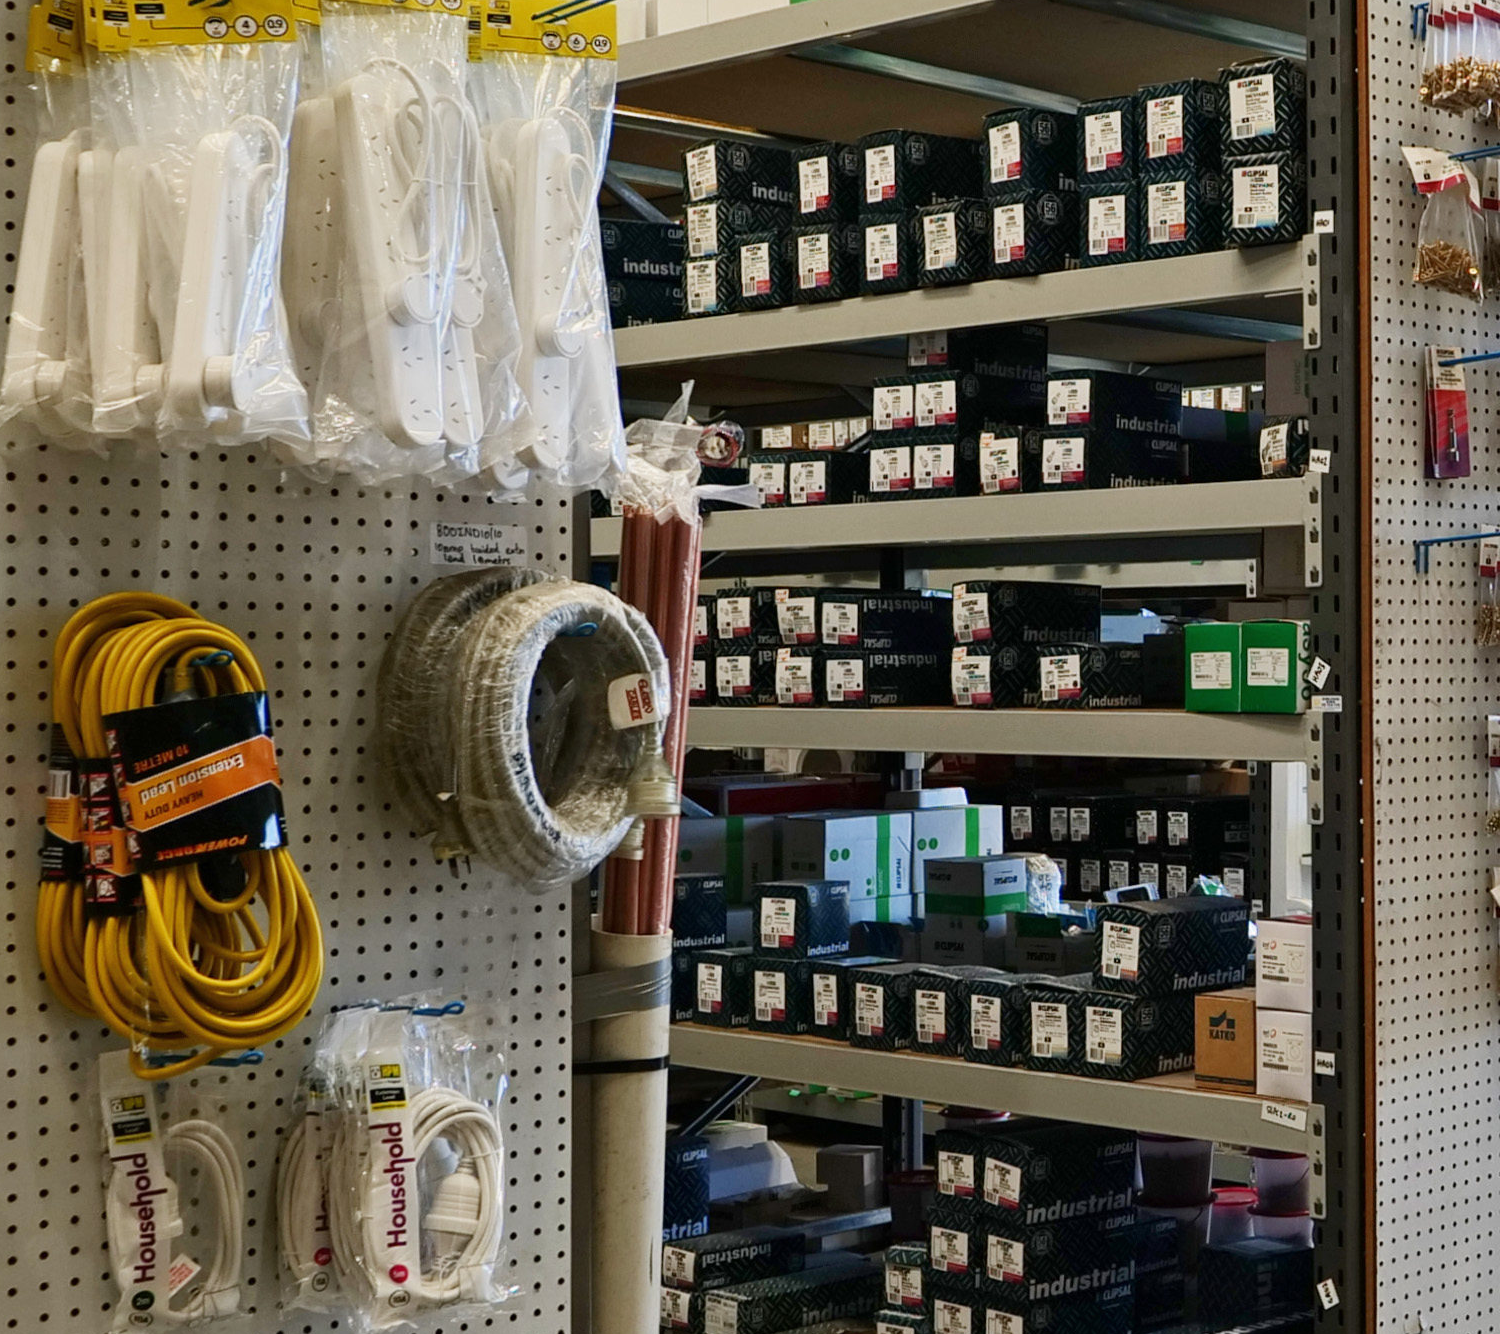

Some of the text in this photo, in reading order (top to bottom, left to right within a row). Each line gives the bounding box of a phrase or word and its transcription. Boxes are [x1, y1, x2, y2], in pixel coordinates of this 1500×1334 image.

[241, 19, 251, 30] 4
[267, 18, 284, 30] 0.9
[572, 36, 581, 47] 6
[594, 38, 609, 49] 0.9
[974, 358, 1047, 382] industrial
[1115, 413, 1181, 437] industrial
[1023, 624, 1100, 643] industrial
[1088, 692, 1142, 708] industrial
[133, 748, 175, 774] METRE
[139, 753, 245, 805] Extension Lead
[143, 788, 204, 821] HEAVY DUTY
[156, 834, 249, 862] POWERFORCE
[702, 879, 724, 890] CLIPSAL
[1218, 909, 1248, 925] CLIPSAL
[674, 933, 726, 949] industrial
[807, 940, 850, 957] industrial
[1172, 964, 1246, 992] industrial
[1208, 1028, 1236, 1042] KATKO
[682, 1147, 708, 1161] CLIPSAL
[1104, 1142, 1134, 1155] CLIPSAL
[368, 1122, 416, 1249] Household
[1025, 1188, 1133, 1225] industrial
[109, 1152, 168, 1284] Household
[1104, 1214, 1136, 1229] CLIPSAL
[702, 1242, 772, 1268] industrial
[1028, 1259, 1136, 1301] industrial
[1101, 1285, 1133, 1301] CLIPSAL
